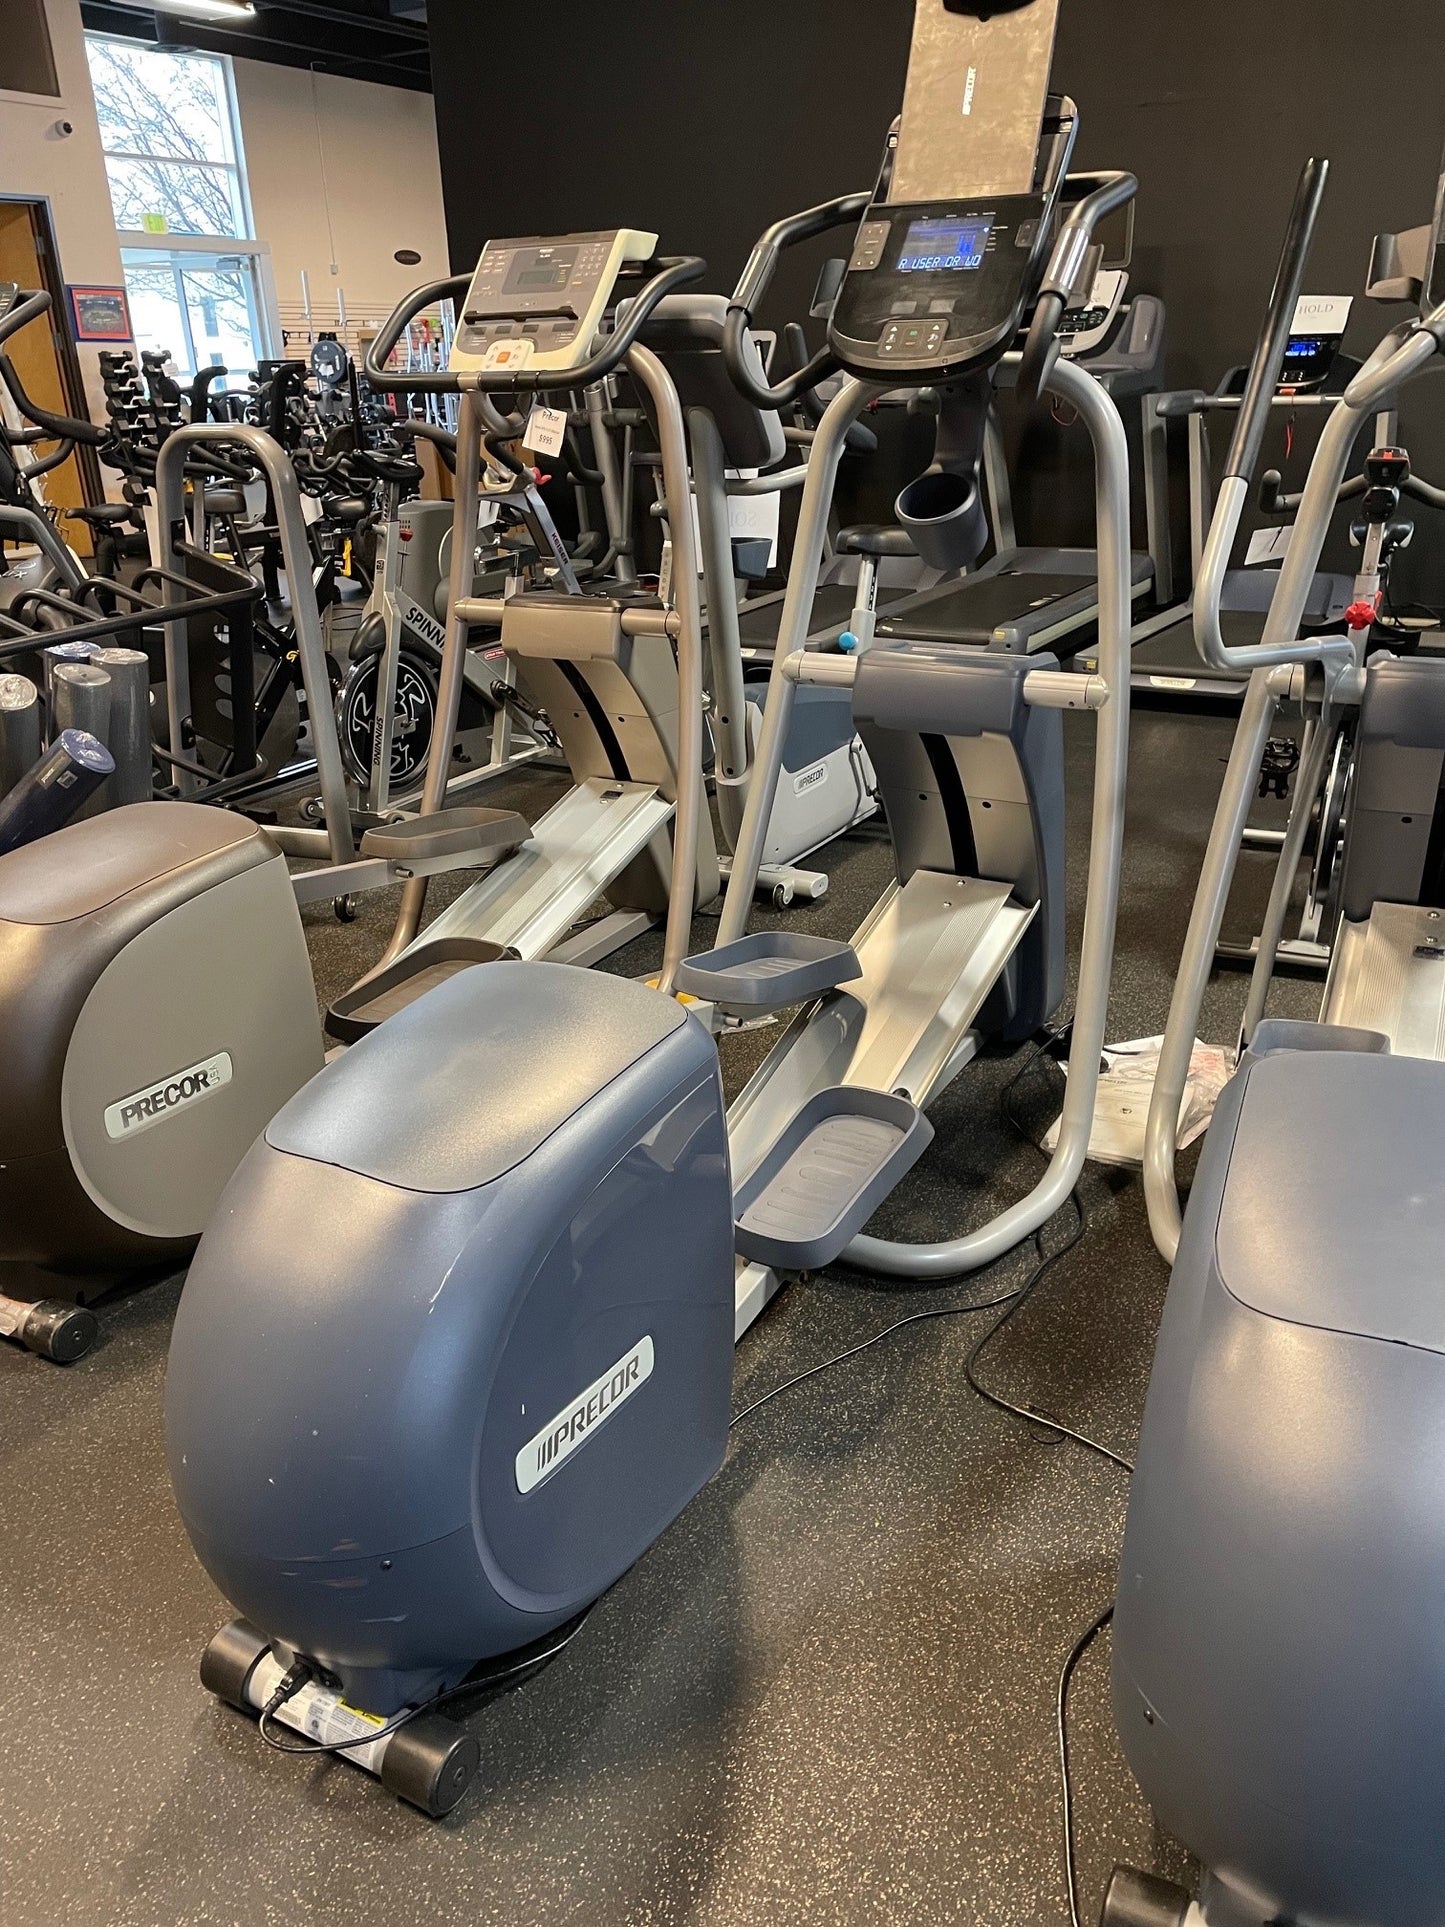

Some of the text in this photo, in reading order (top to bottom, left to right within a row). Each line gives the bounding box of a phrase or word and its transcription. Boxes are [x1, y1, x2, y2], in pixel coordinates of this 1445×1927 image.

[962, 65, 977, 112] PRECOR
[911, 257, 940, 269] USER
[945, 256, 961, 267] OR
[1299, 303, 1334, 315] HOLD
[551, 532, 569, 565] KEISER
[373, 715, 384, 767] SPINNING
[801, 767, 824, 788] PRECOR
[119, 1060, 221, 1129] PRECOR USA
[549, 1354, 640, 1461] PRECOR
